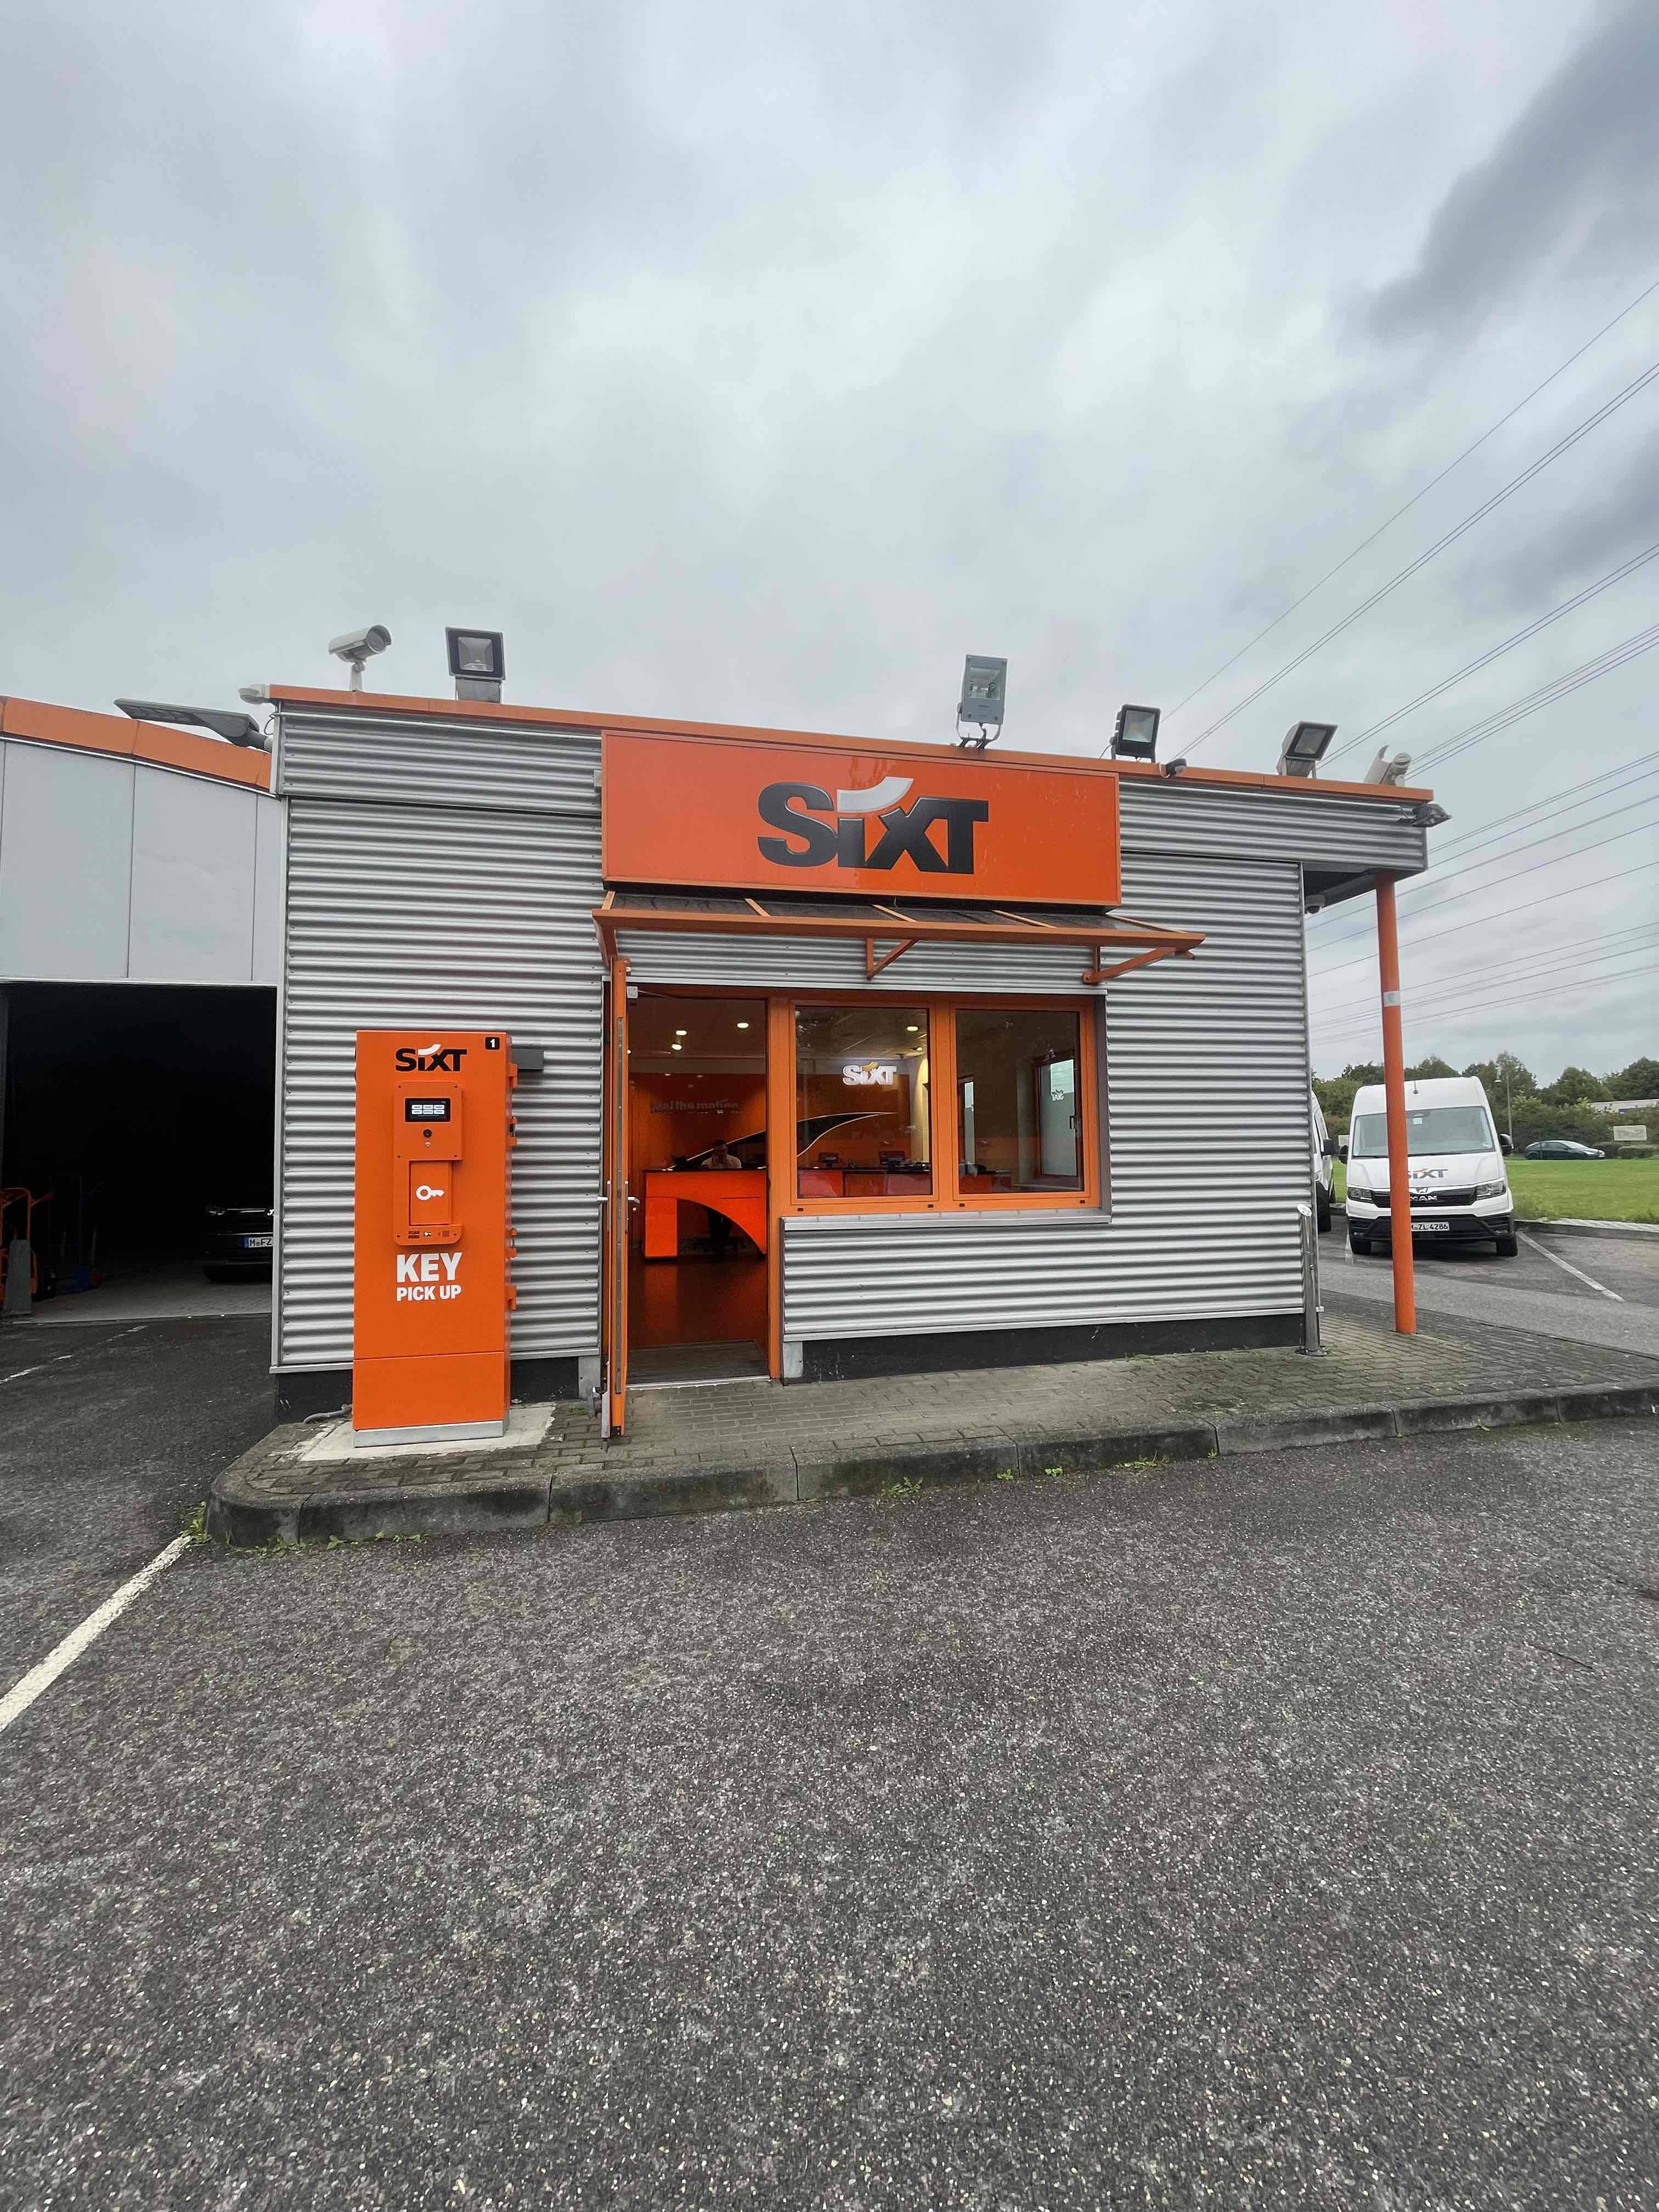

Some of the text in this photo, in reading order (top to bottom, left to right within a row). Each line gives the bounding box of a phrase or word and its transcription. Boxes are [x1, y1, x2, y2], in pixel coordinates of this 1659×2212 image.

[758, 776, 988, 874] SIXT
[490, 1039, 495, 1047] 1
[395, 1044, 467, 1071] SIXT
[843, 1062, 897, 1085] SIXT
[397, 1252, 462, 1283] KEY
[397, 1285, 461, 1301] PICK UP
